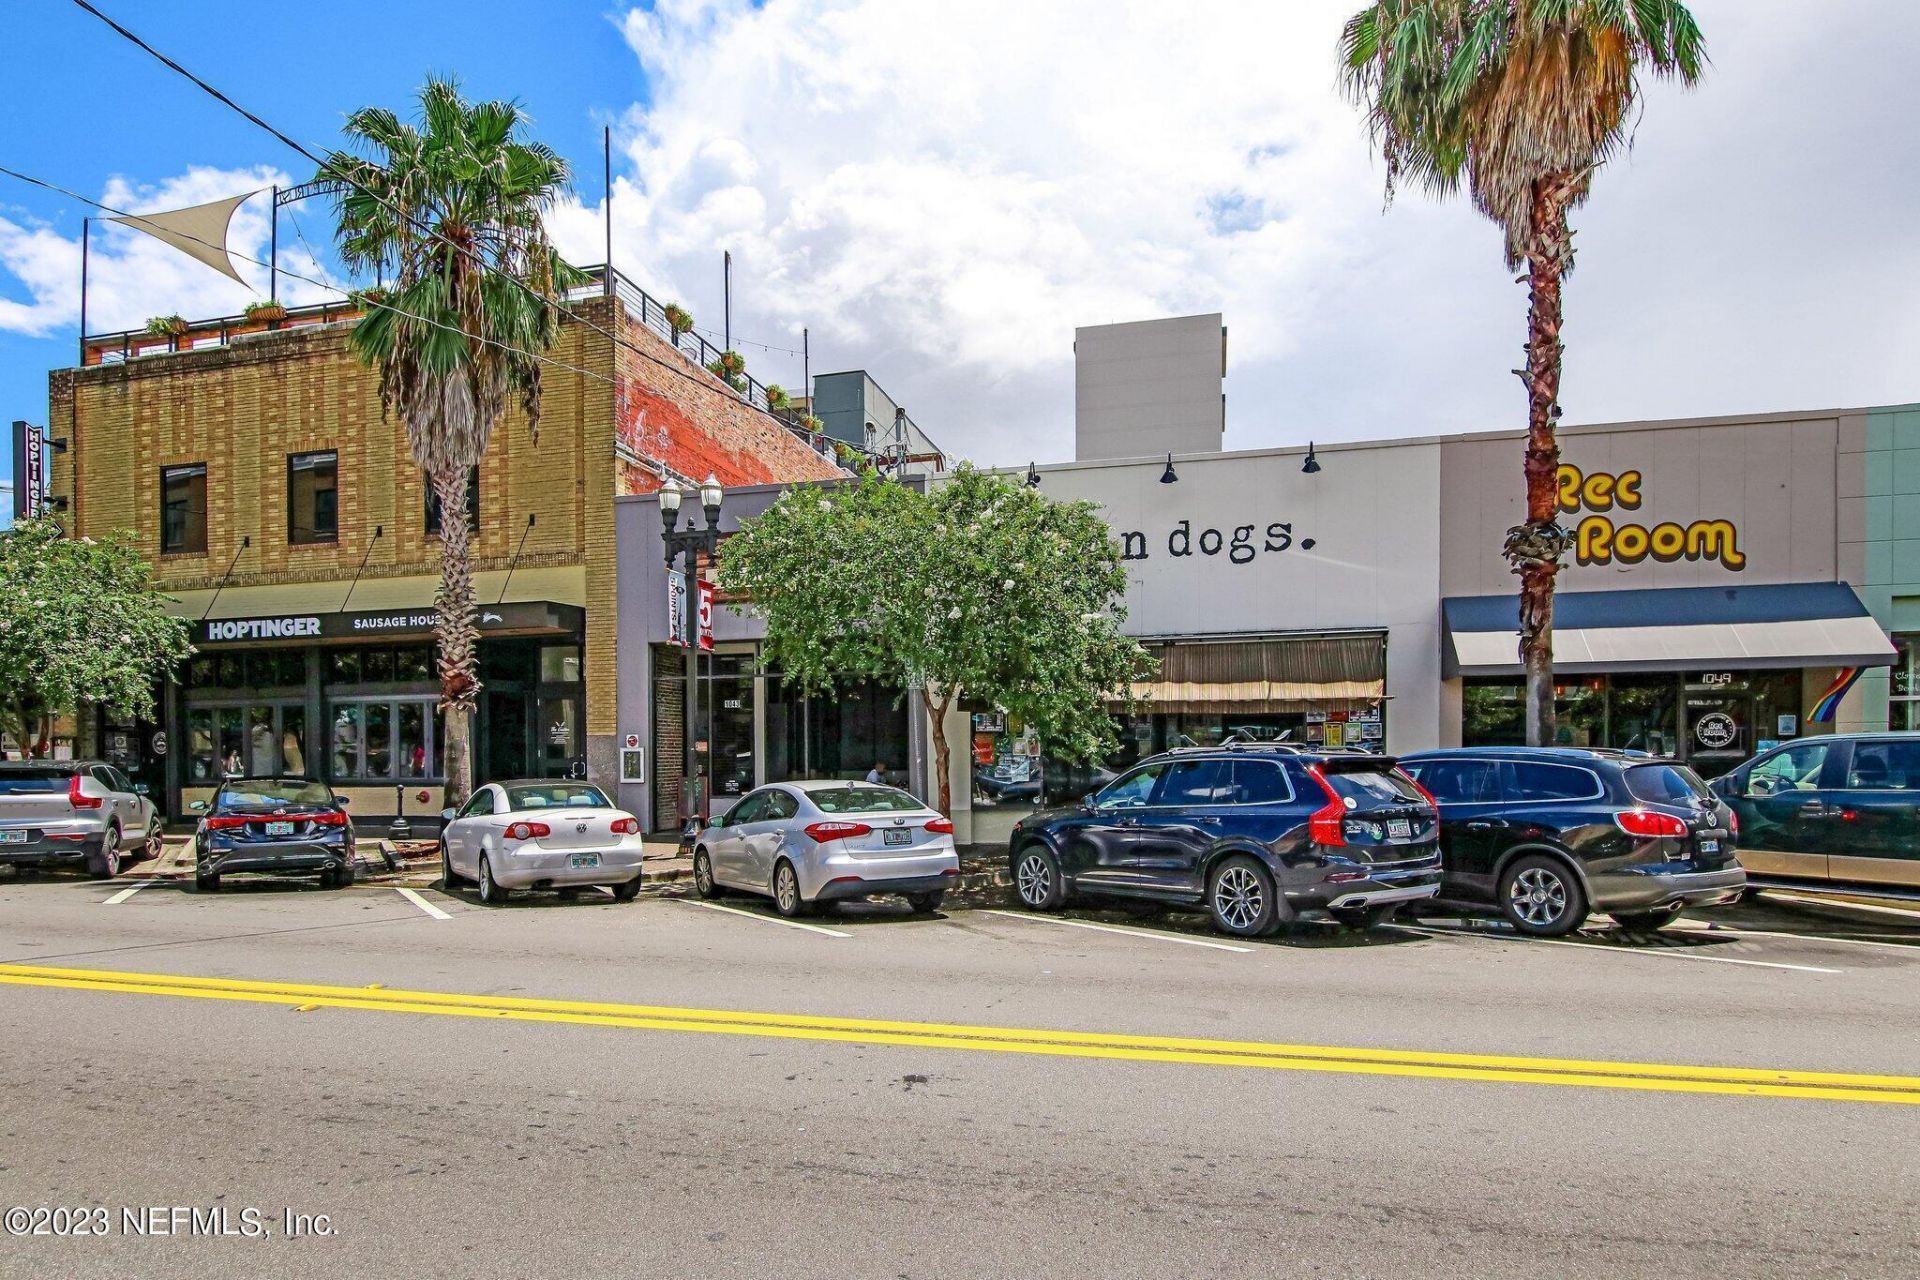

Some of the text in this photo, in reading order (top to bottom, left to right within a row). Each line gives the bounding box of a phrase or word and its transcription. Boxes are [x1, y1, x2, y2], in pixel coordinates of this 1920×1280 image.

[29, 431, 40, 518] HOPTINGER
[1555, 463, 1642, 514] Rec
[1168, 520, 1316, 564] dogs.
[1576, 515, 1746, 572] Room
[208, 617, 322, 640] HOPTINGER
[354, 615, 442, 629] SAUSAGE HOUS
[700, 589, 712, 628] 5
[1702, 673, 1732, 684] 1049
